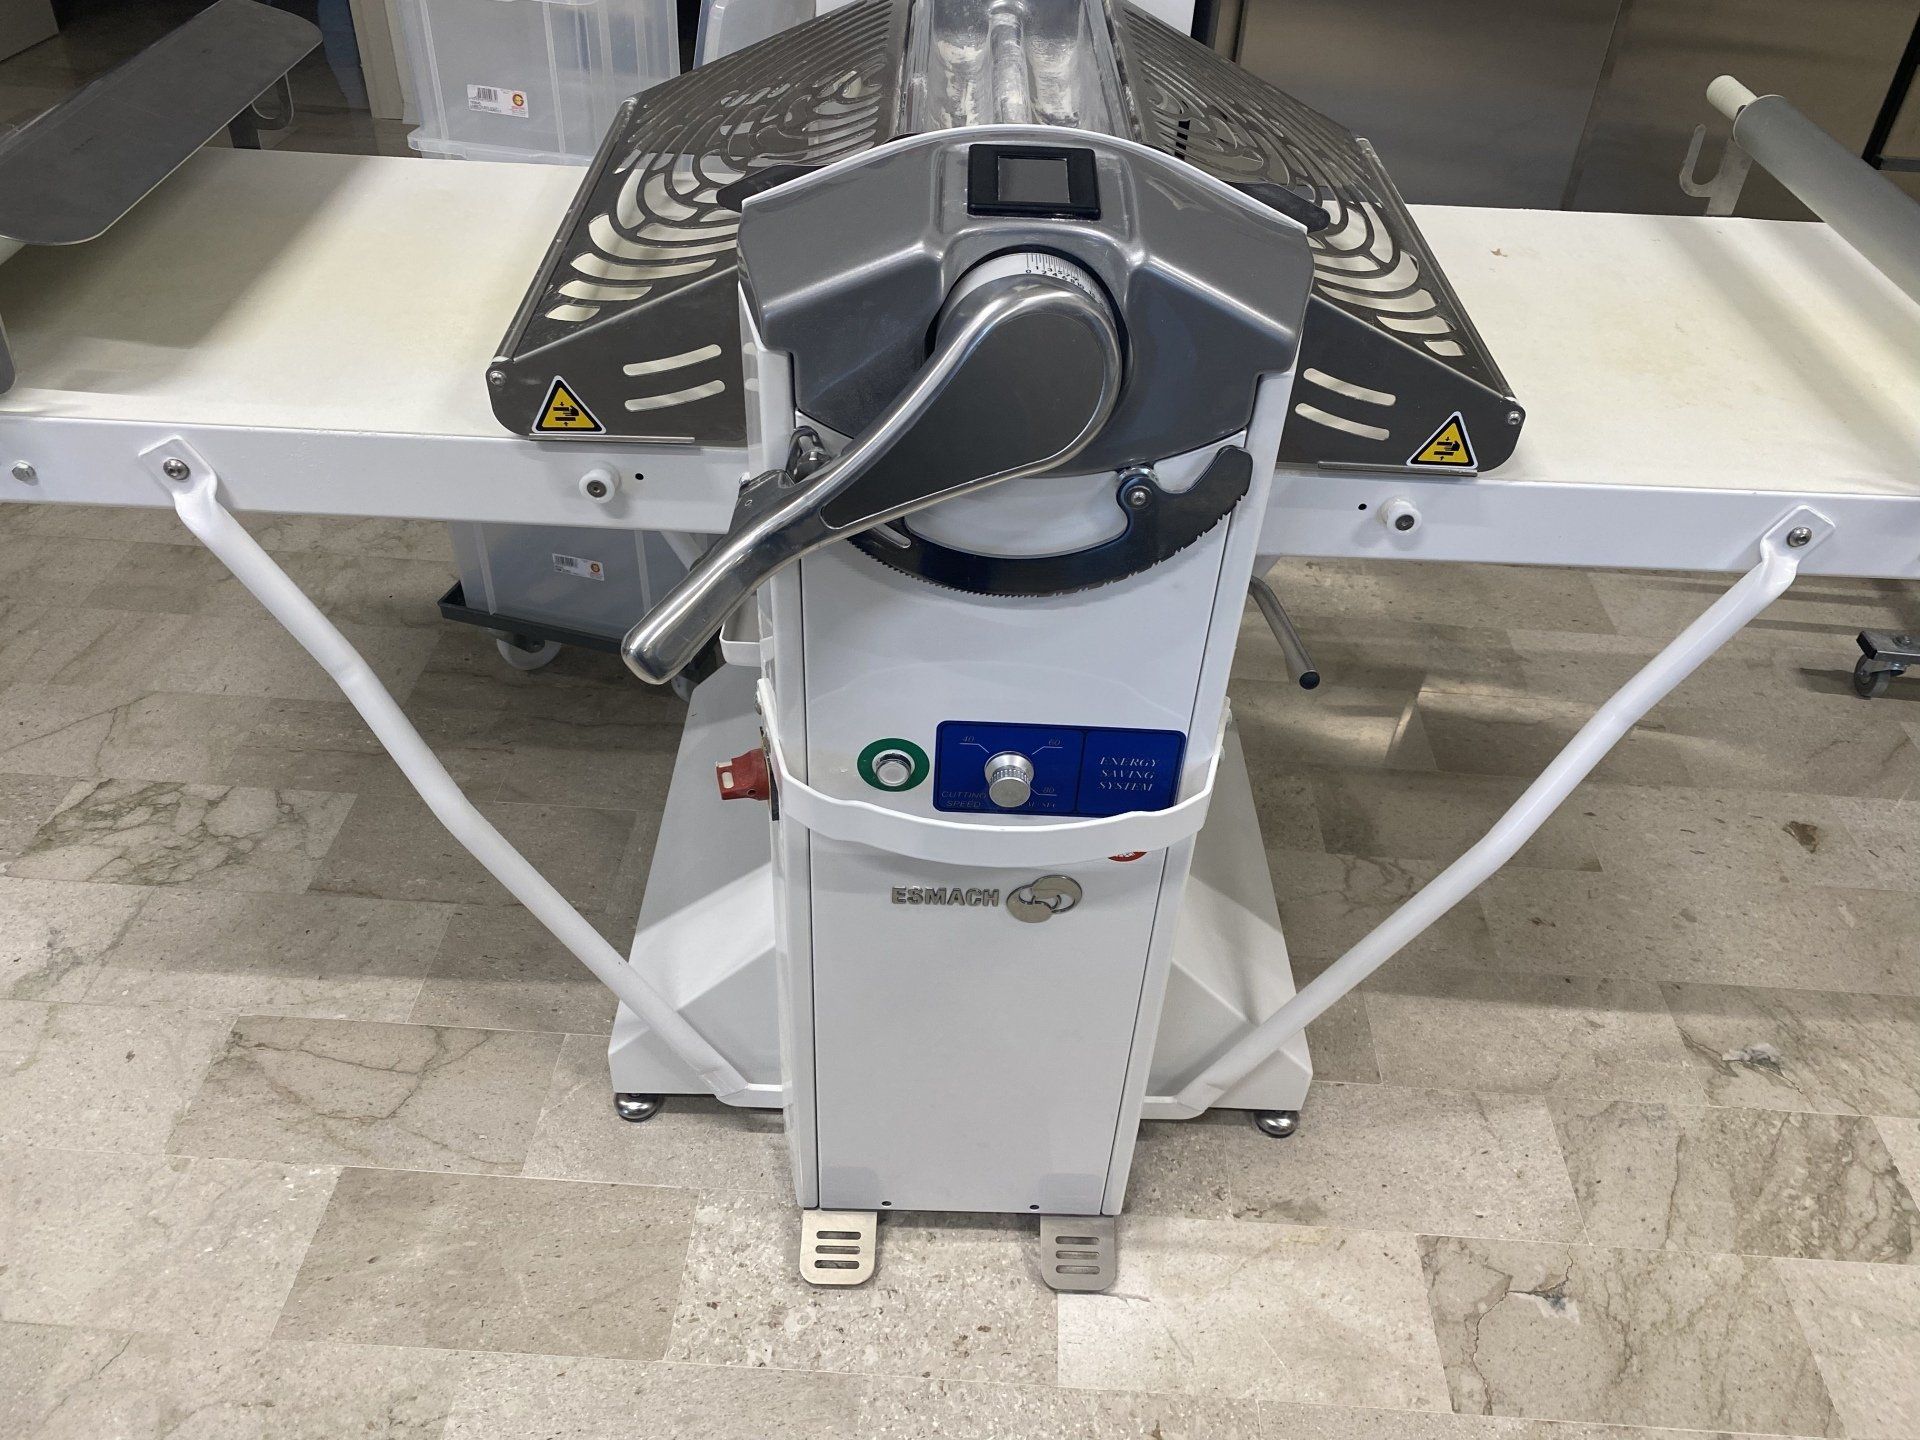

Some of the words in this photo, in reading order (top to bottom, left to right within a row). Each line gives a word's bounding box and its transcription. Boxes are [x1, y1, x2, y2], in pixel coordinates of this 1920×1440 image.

[1048, 738, 1061, 746] 60
[1098, 756, 1159, 768] ENERGY
[1101, 768, 1155, 780] SAVING
[1098, 780, 1153, 792] SYSTEM
[941, 790, 987, 800] CUTTING
[946, 800, 981, 809] SPEED
[891, 885, 1000, 907] ESMACH
